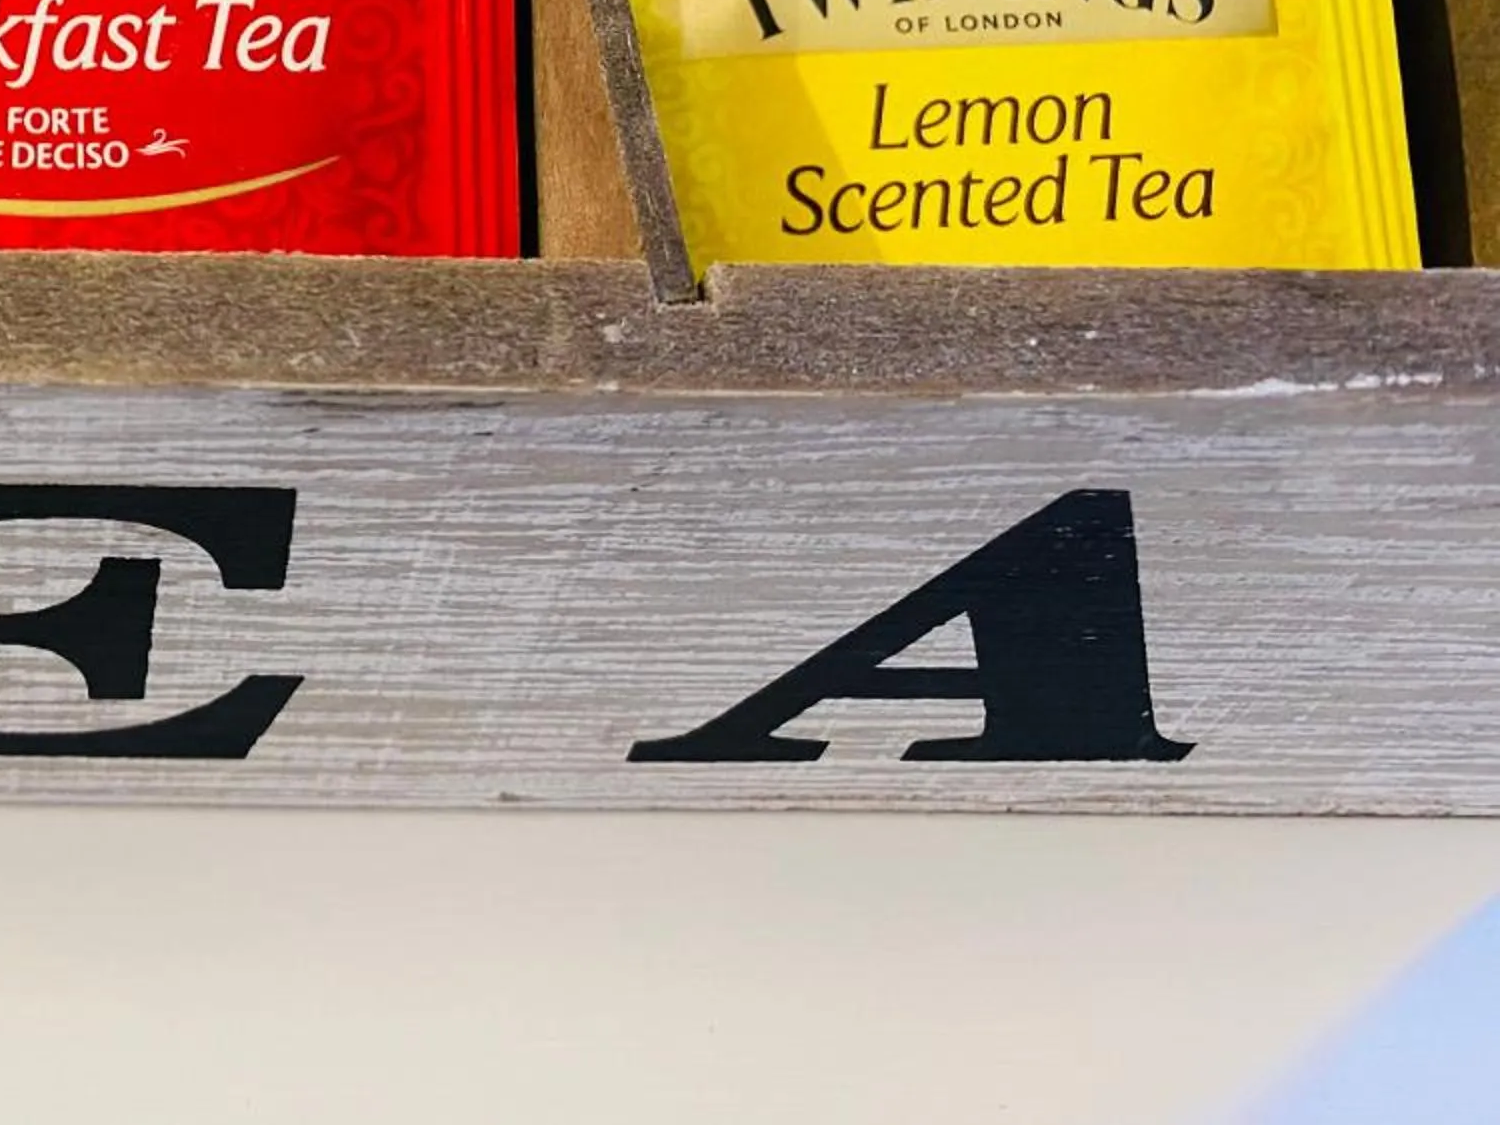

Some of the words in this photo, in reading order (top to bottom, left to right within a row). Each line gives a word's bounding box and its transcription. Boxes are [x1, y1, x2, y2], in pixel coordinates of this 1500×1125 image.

[895, 16, 930, 35] OF
[944, 11, 1063, 33] LONDON
[7, 107, 109, 135] FORTE
[869, 83, 1113, 150] Lemon
[10, 142, 130, 170] DECISO
[781, 156, 1066, 236] Scented
[1088, 152, 1215, 222] Tea
